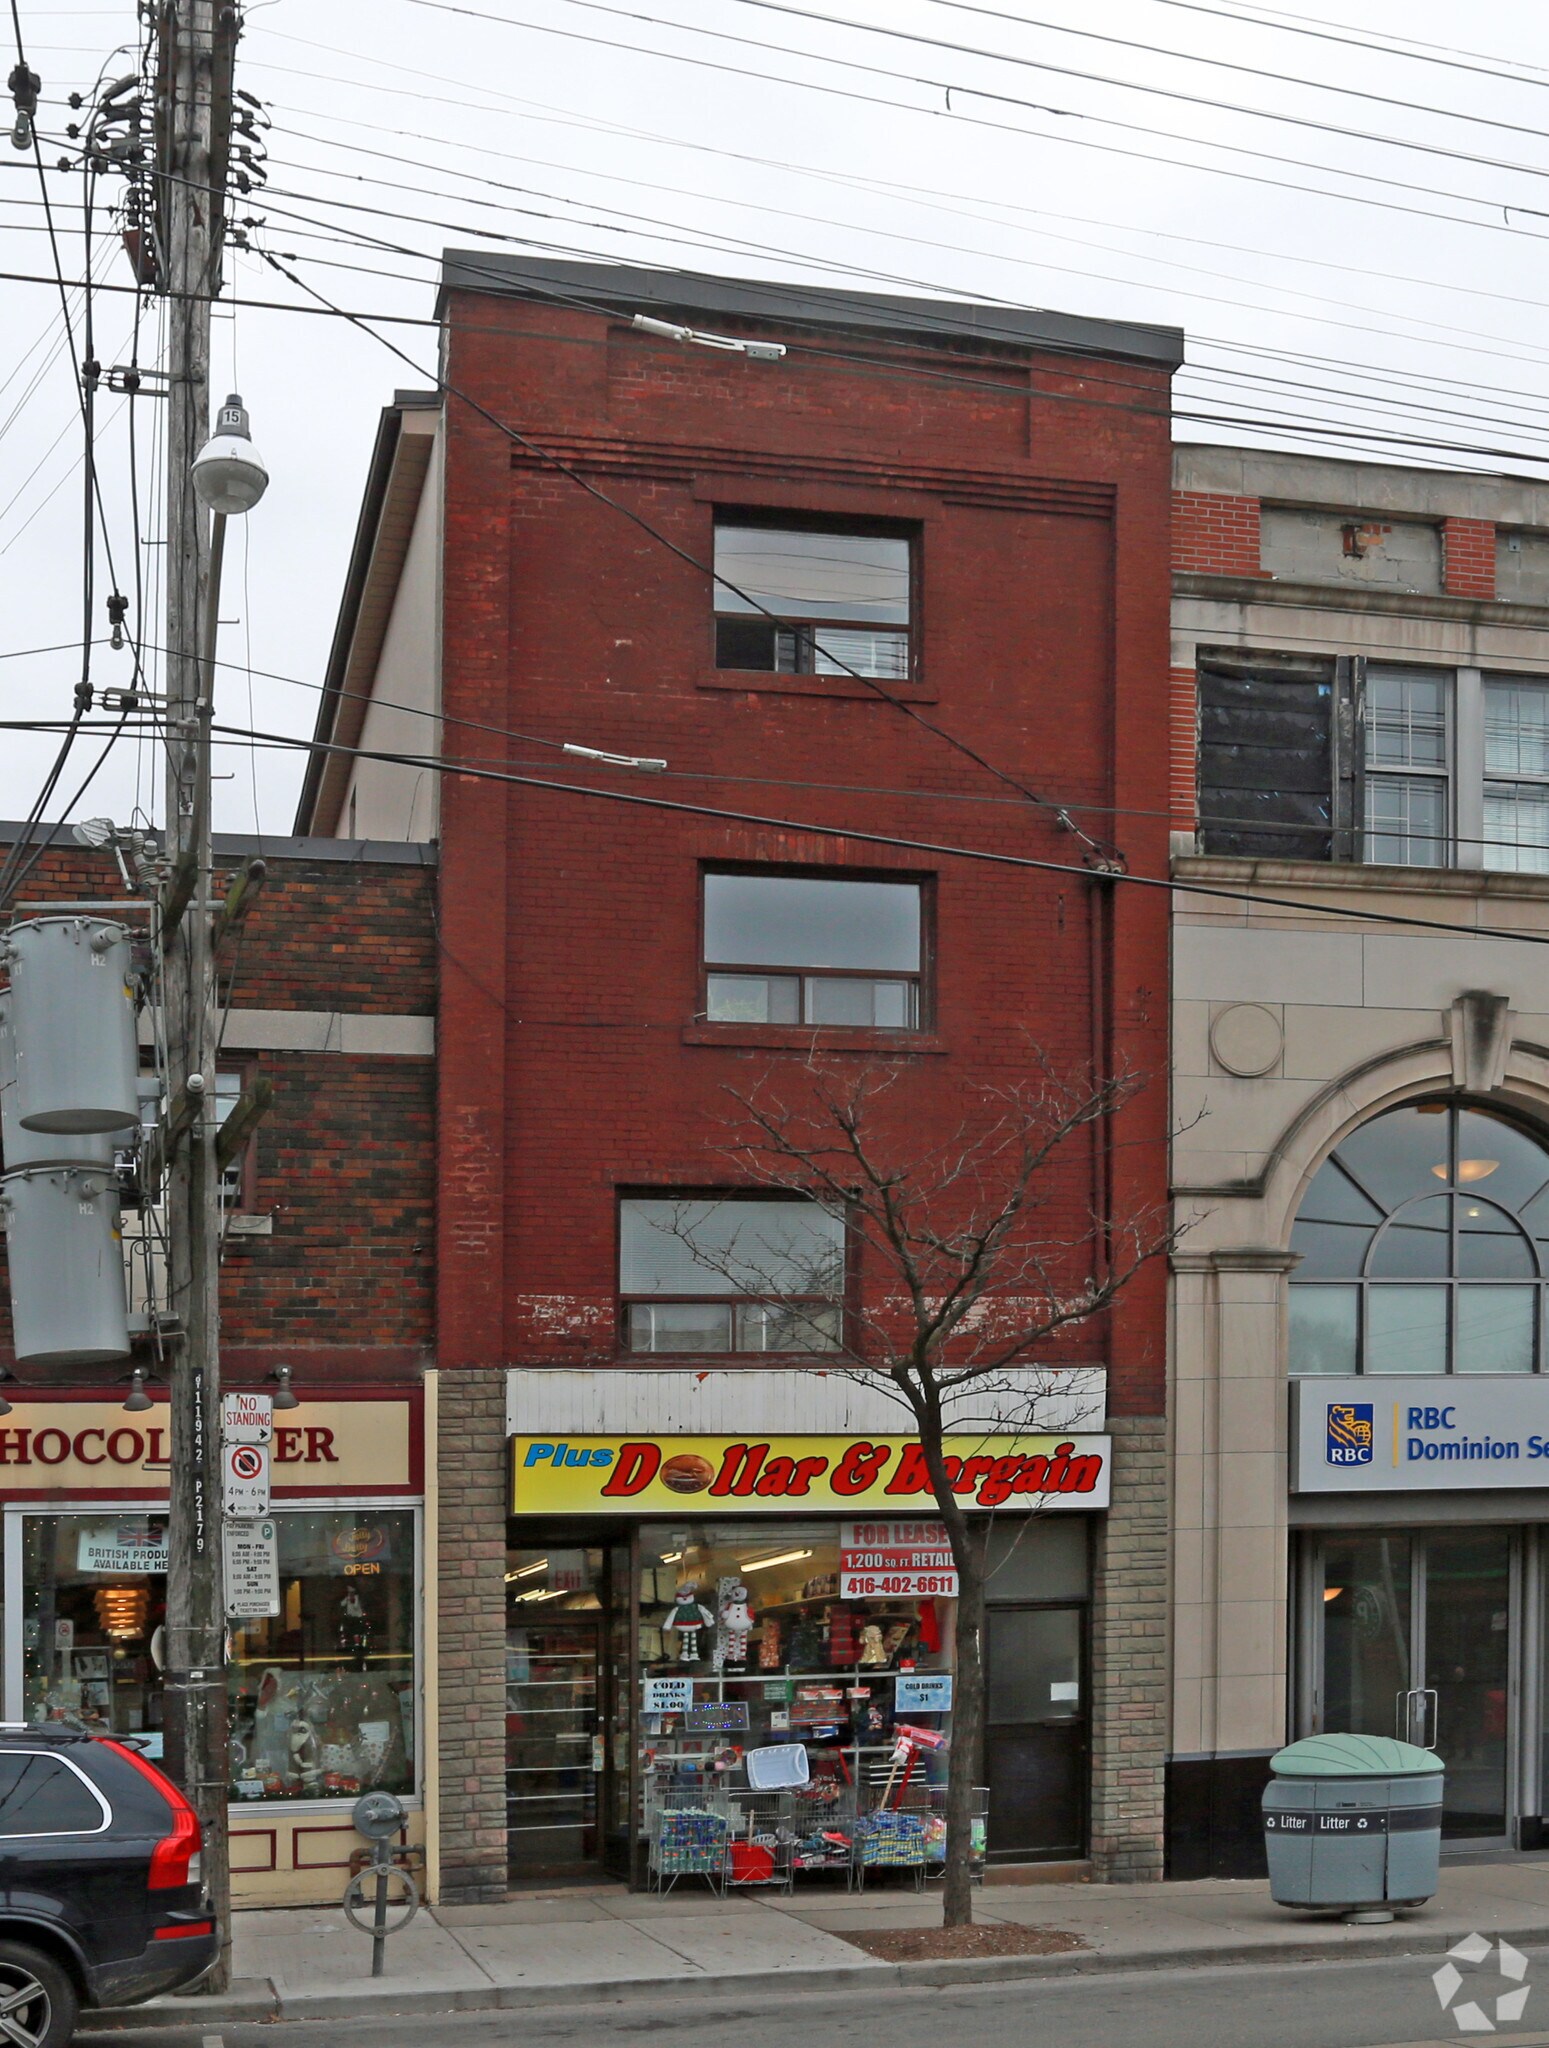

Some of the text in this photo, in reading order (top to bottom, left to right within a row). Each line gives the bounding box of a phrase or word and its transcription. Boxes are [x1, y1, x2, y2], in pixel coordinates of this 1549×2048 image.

[224, 410, 239, 422] 15
[91, 953, 106, 966] H2
[79, 1203, 94, 1215] H2
[240, 1397, 257, 1411] NO
[226, 1411, 270, 1426] STANDING
[1407, 1406, 1456, 1430] RBC
[1331, 1448, 1370, 1462] RBC
[1407, 1436, 1520, 1461] Dominion
[523, 1443, 615, 1468] Plus
[830, 1442, 892, 1496] &
[853, 1524, 949, 1546] FOR LEASE
[88, 1547, 129, 1559] BRITISH
[93, 1559, 149, 1570] AVAILABLE
[845, 1553, 883, 1569] 1,200
[911, 1552, 955, 1567] RETAIL
[344, 1562, 380, 1576] OPEN
[847, 1576, 953, 1594] 416-402-6611
[653, 1682, 685, 1690] COLD
[921, 1682, 943, 1690] DRINKS
[919, 1693, 928, 1702] $1
[654, 1701, 685, 1709] $1.00
[1281, 1816, 1350, 1829] Litter Litter
